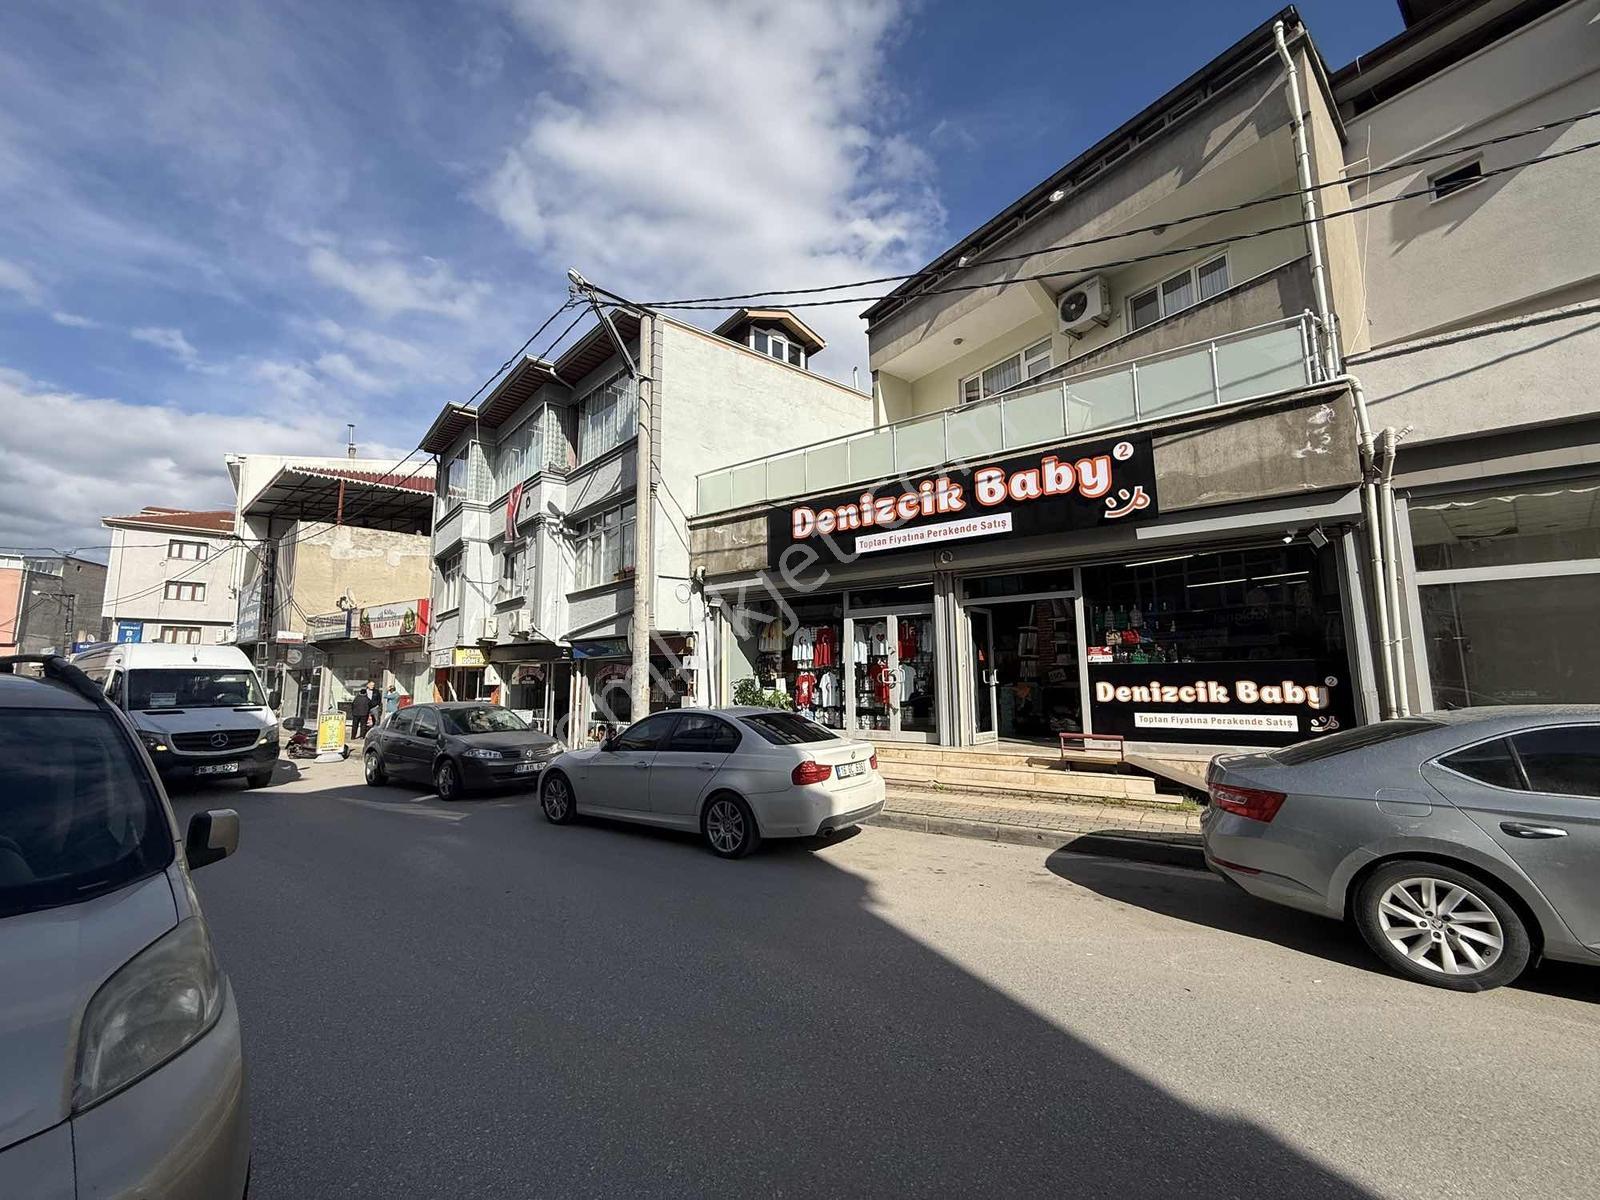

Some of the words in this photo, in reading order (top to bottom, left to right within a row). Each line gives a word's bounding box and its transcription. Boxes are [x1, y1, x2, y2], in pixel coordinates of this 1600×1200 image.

[792, 477, 966, 539] Denizcik
[975, 455, 1113, 507] Baby
[859, 538, 888, 550] Toptan
[889, 532, 925, 545] Fiyatına
[927, 523, 978, 538] Perakende
[980, 518, 1007, 531] Satış
[1095, 680, 1231, 703] Denizcik
[1235, 680, 1329, 709] Baby
[1139, 715, 1168, 725] Toptan
[1170, 716, 1208, 726] Fiyatına
[1210, 717, 1264, 727] Perakende
[1266, 718, 1293, 728] Satış
